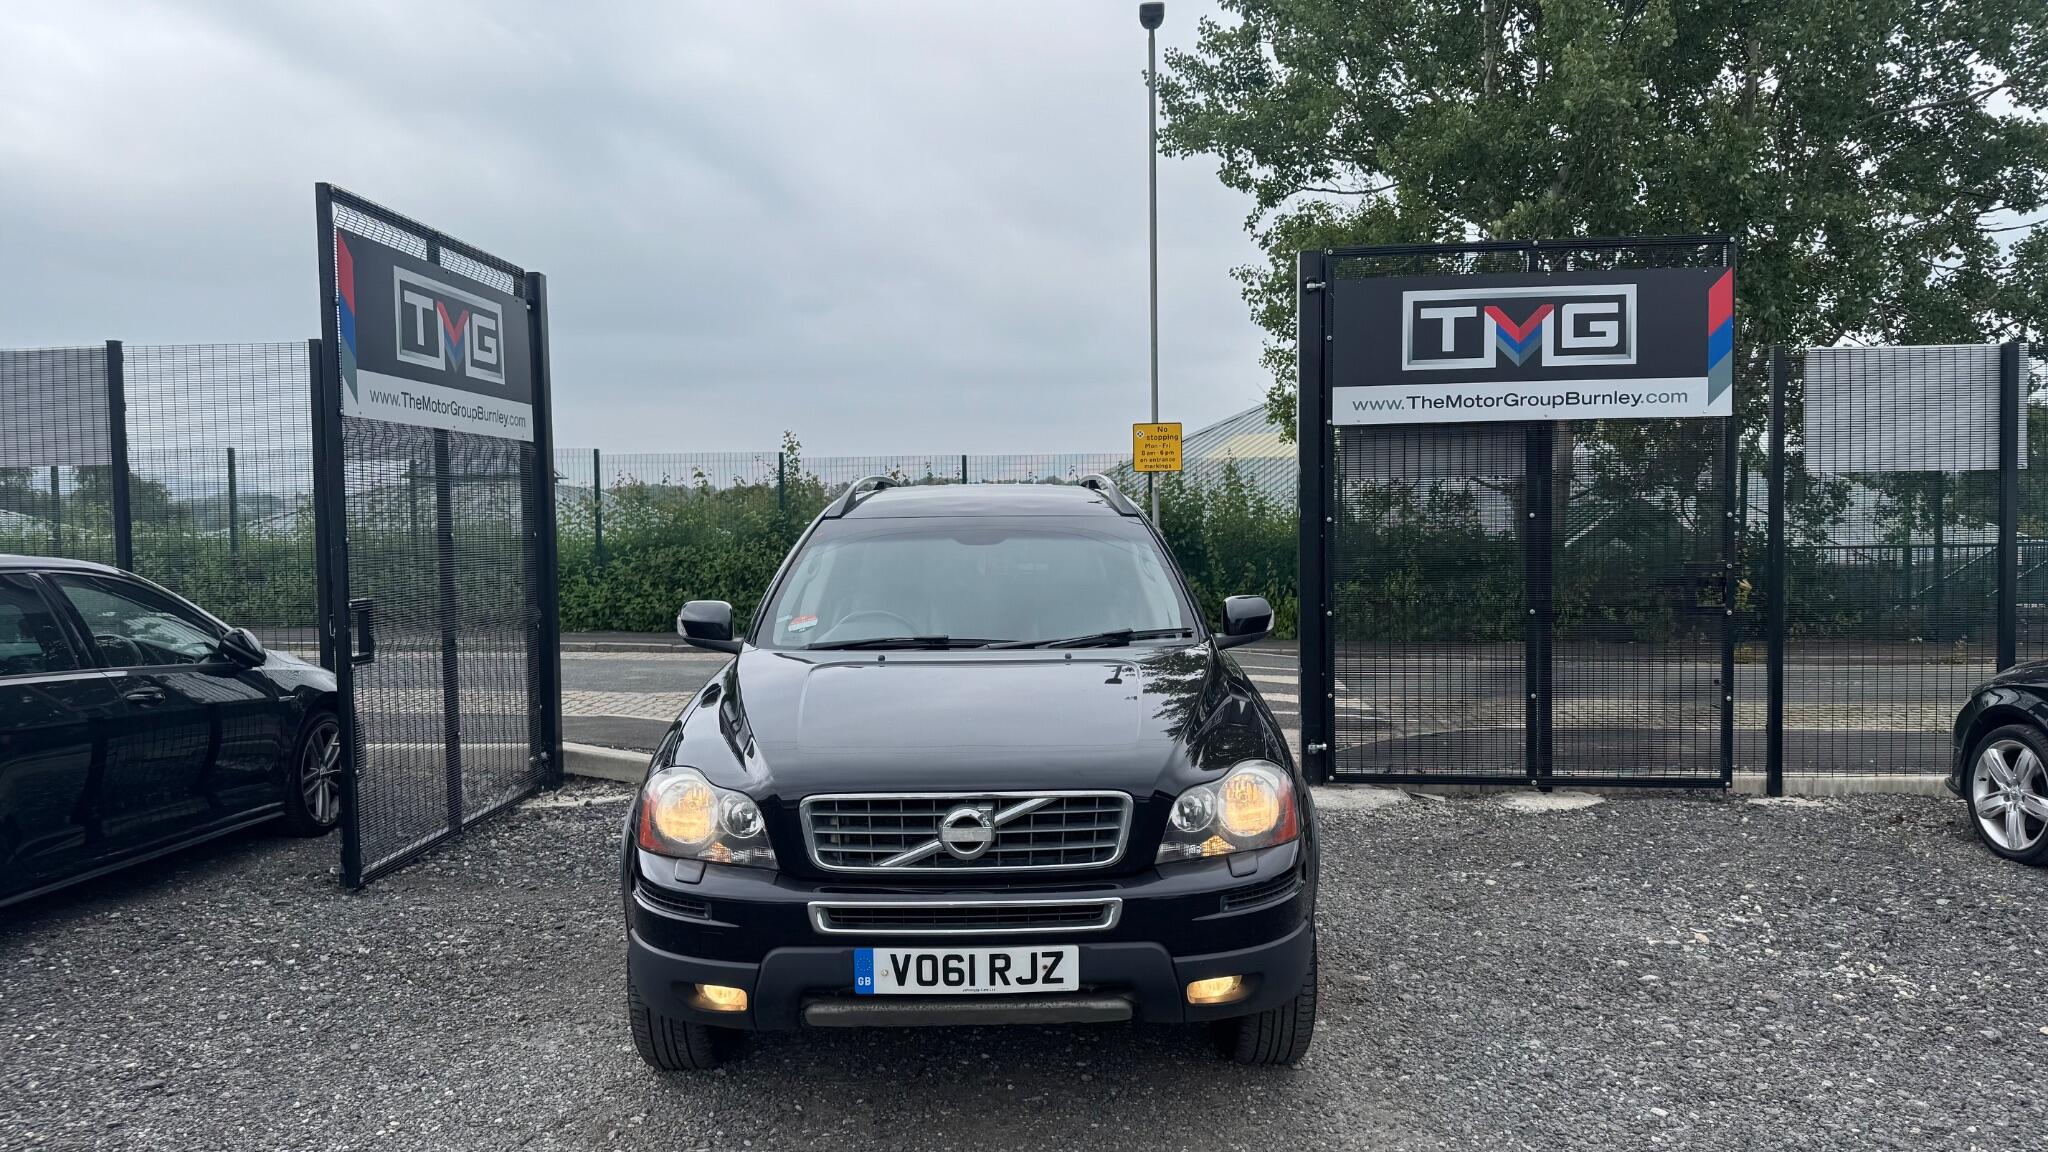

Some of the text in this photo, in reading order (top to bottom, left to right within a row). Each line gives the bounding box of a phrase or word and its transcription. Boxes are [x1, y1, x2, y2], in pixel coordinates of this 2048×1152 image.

[404, 289, 498, 373] TMG
[1420, 301, 1620, 368] TMG
[369, 388, 527, 428] www.TheMotorGroupBurnley.com
[1351, 389, 1689, 412] www.TheMotorGroupBurnley.com
[857, 976, 872, 986] GB
[889, 950, 1064, 987] VO61 RJZ
